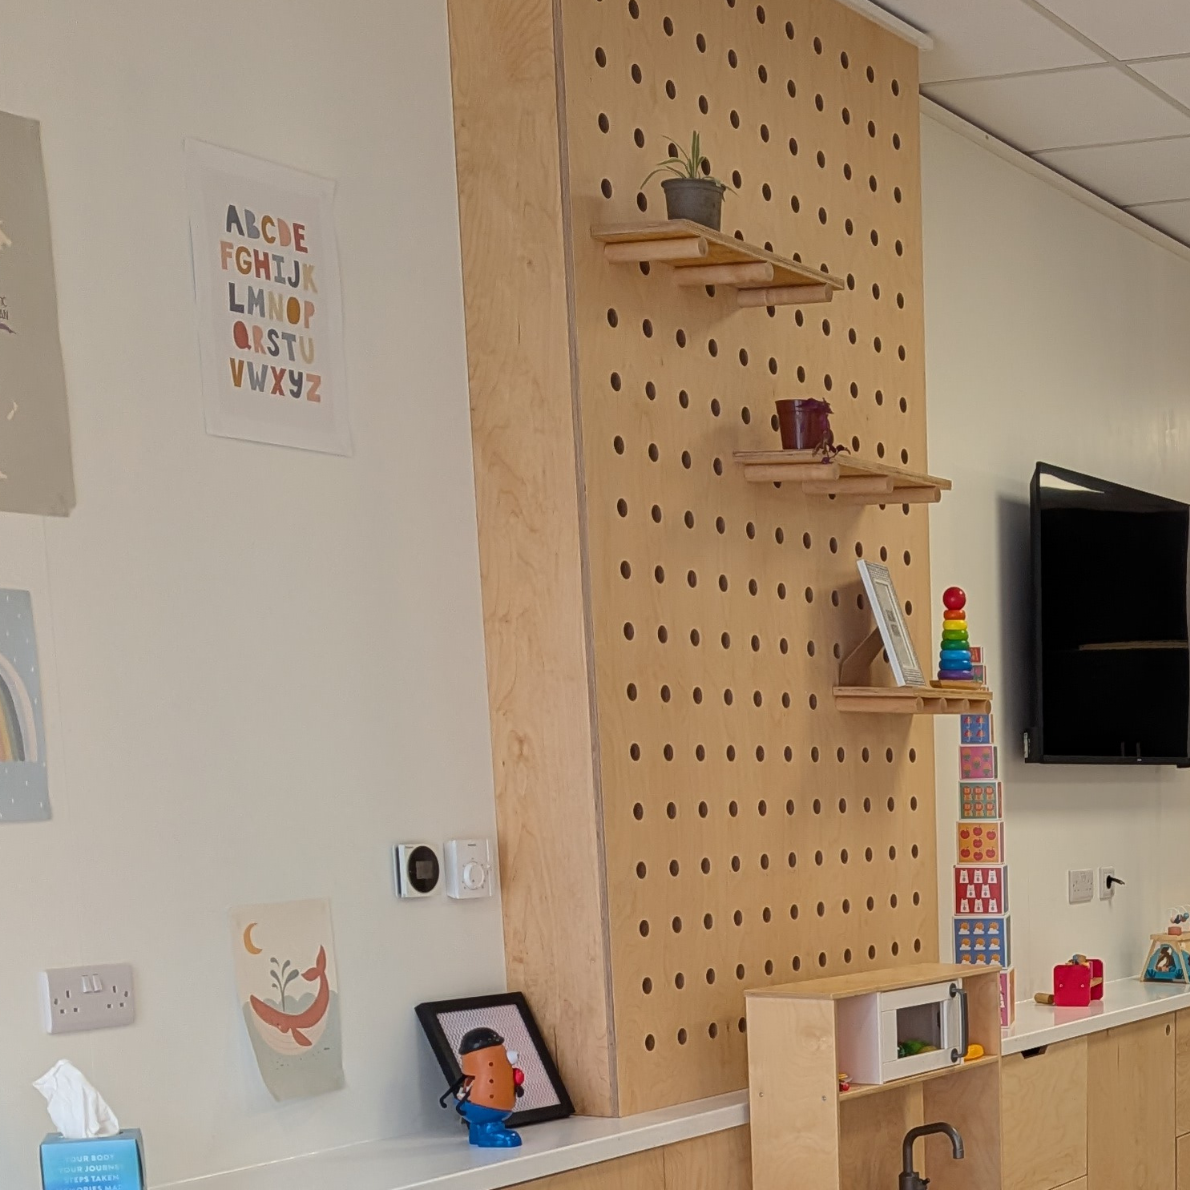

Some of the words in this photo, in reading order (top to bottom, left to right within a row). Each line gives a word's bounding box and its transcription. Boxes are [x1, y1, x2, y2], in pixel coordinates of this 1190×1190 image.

[226, 204, 308, 253] ABCDE
[220, 240, 318, 294] FGHIJK
[228, 282, 315, 329] LMNOP
[233, 320, 315, 364] QRSTU
[229, 357, 321, 403] VWXYZ
[58, 1166, 83, 1174] YOUR
[64, 1155, 89, 1163] YOUR
[91, 1154, 115, 1162] BODY
[64, 1175, 90, 1184] STEPS
[91, 1174, 120, 1182] TAKEN
